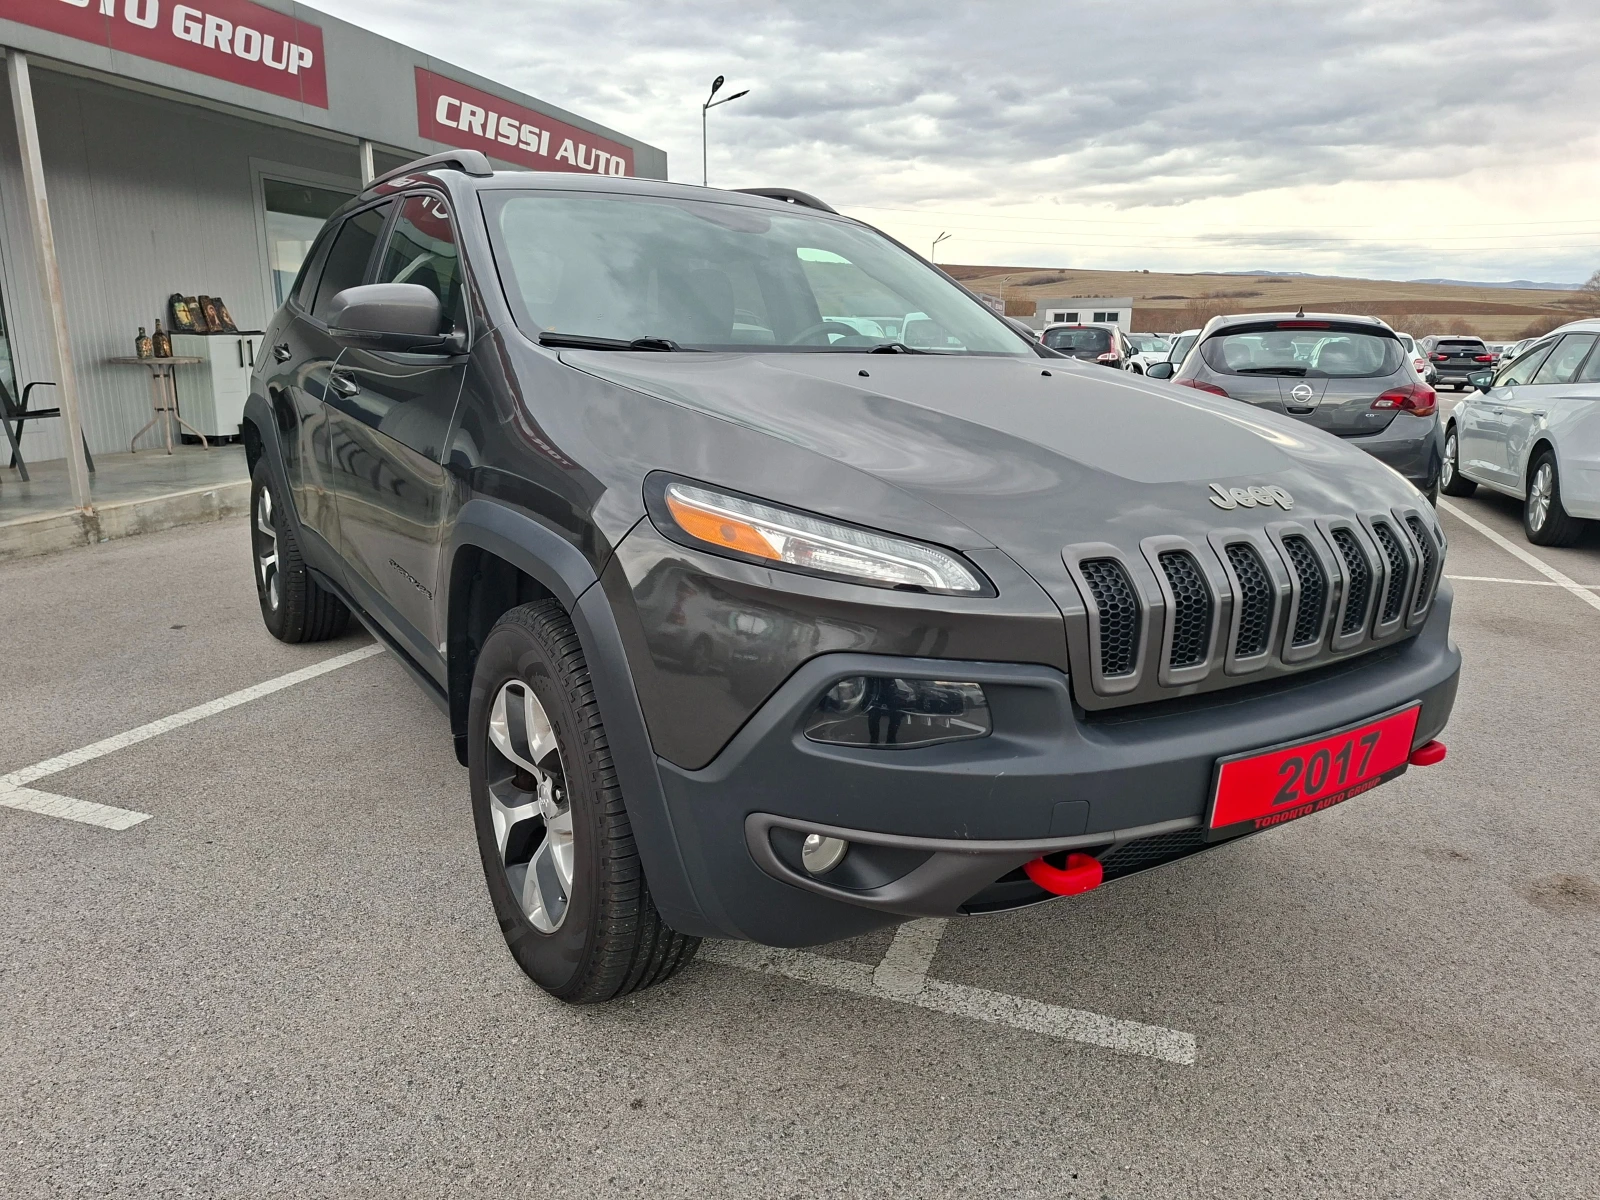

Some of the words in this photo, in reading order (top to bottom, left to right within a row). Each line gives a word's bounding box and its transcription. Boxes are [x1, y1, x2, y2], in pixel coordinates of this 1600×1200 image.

[172, 4, 313, 75] GROUP
[436, 95, 550, 156] CRISSI
[555, 138, 626, 176] AUTO
[1209, 483, 1294, 511] Jeep
[1254, 804, 1313, 829] TORONTO
[1315, 792, 1345, 811] AUTO
[1347, 776, 1382, 798] GROUP
[1271, 730, 1382, 807] 2017
